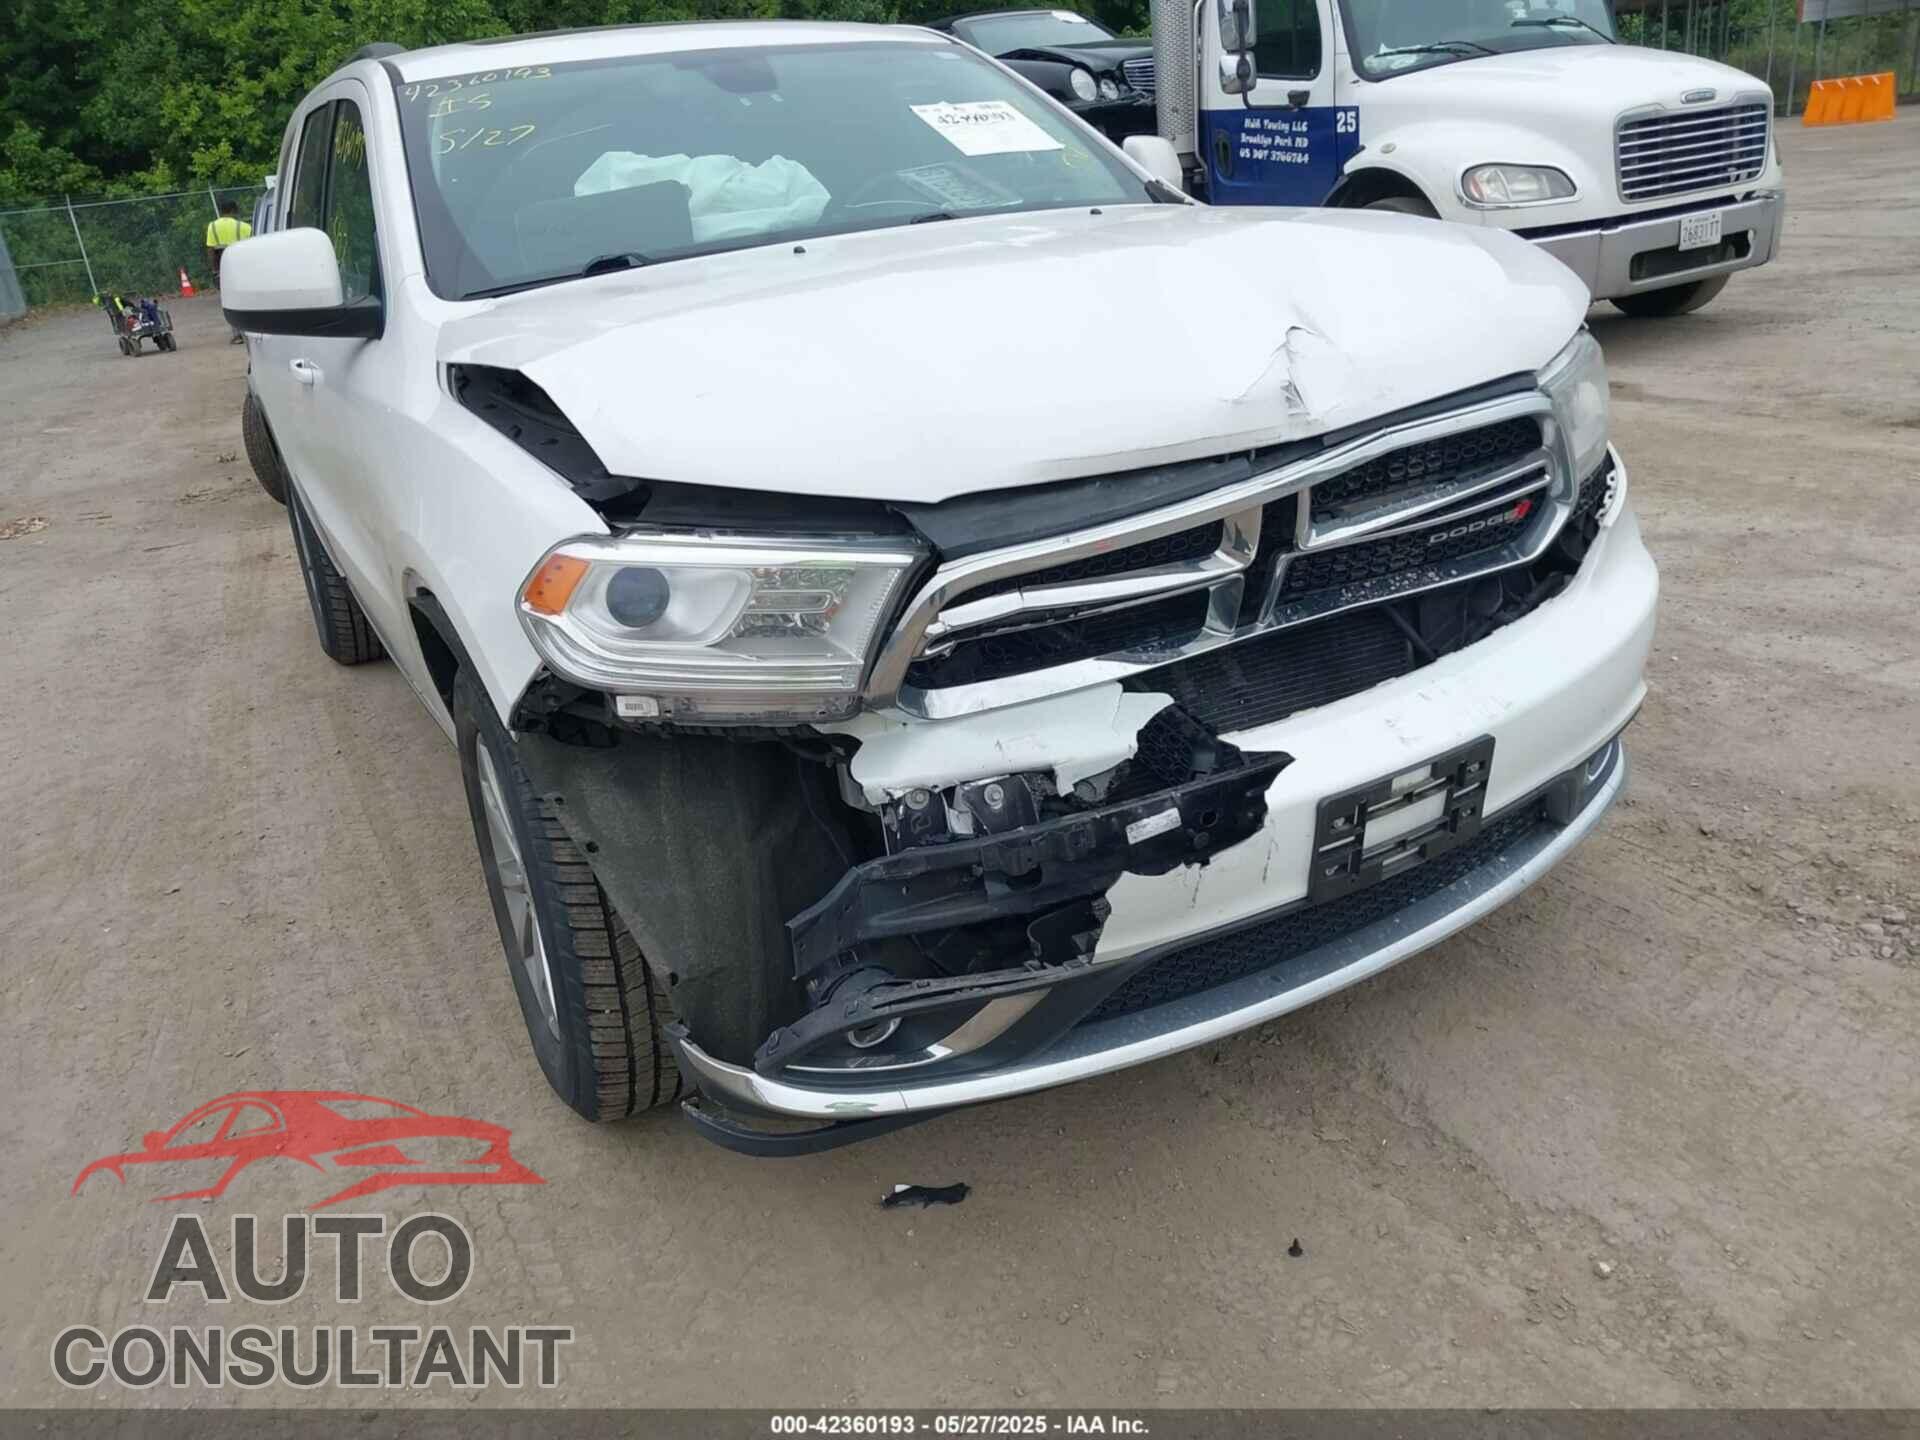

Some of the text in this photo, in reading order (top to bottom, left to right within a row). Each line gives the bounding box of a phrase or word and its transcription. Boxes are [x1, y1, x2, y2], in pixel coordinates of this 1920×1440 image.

[404, 66, 552, 102] 42360193
[1263, 119, 1290, 133] Towing
[1292, 121, 1309, 132] LLC
[1336, 111, 1357, 133] 25
[437, 125, 536, 154] 5/27
[1274, 135, 1293, 147] Park
[1239, 148, 1251, 158] US
[1252, 149, 1269, 160] DOT
[1429, 508, 1519, 544] DODGE
